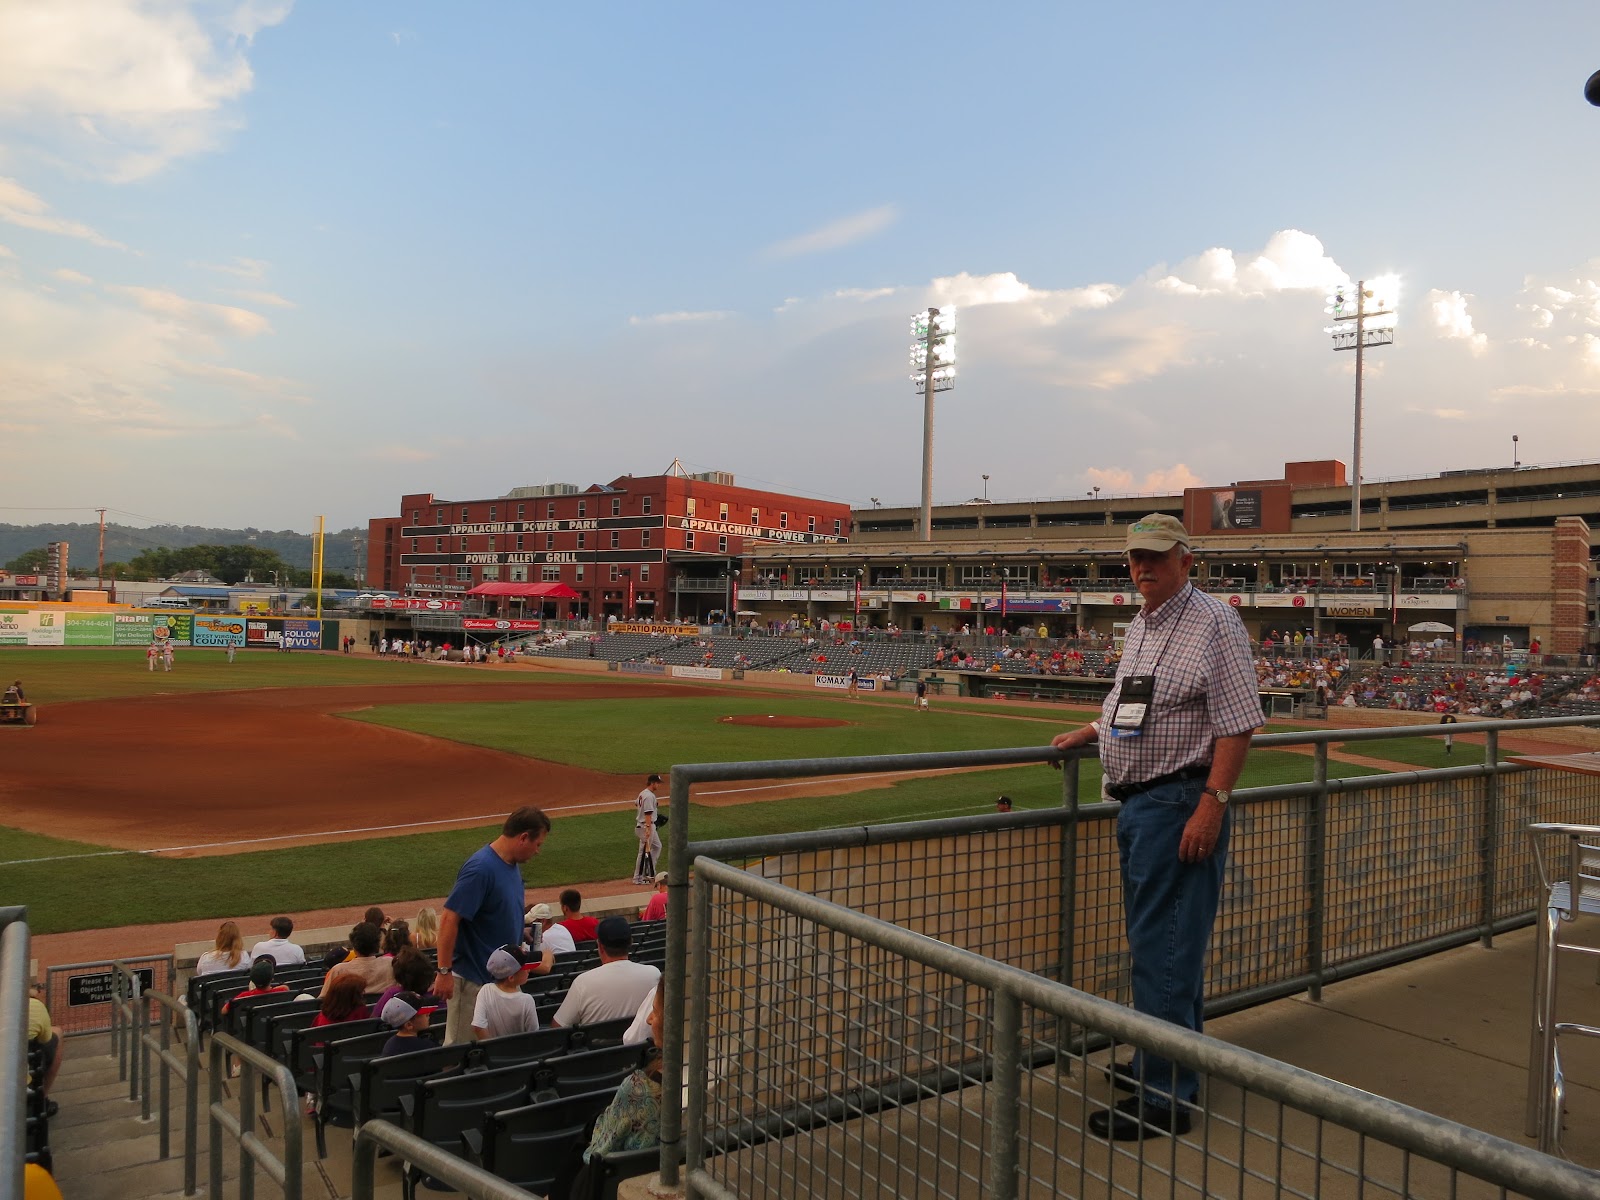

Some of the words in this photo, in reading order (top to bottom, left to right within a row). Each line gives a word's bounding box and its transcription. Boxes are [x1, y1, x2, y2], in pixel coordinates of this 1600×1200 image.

[450, 523, 514, 534] APPALACHIAN
[522, 521, 560, 532] POWER
[569, 520, 598, 530] PARK
[680, 518, 762, 537] APPALACHIAN
[768, 529, 804, 542] POWER
[465, 554, 498, 564] POWER
[507, 554, 536, 563] ALLEY
[546, 552, 577, 562] GRILL
[265, 630, 281, 639] LINE
[816, 676, 845, 685] KOMAX
